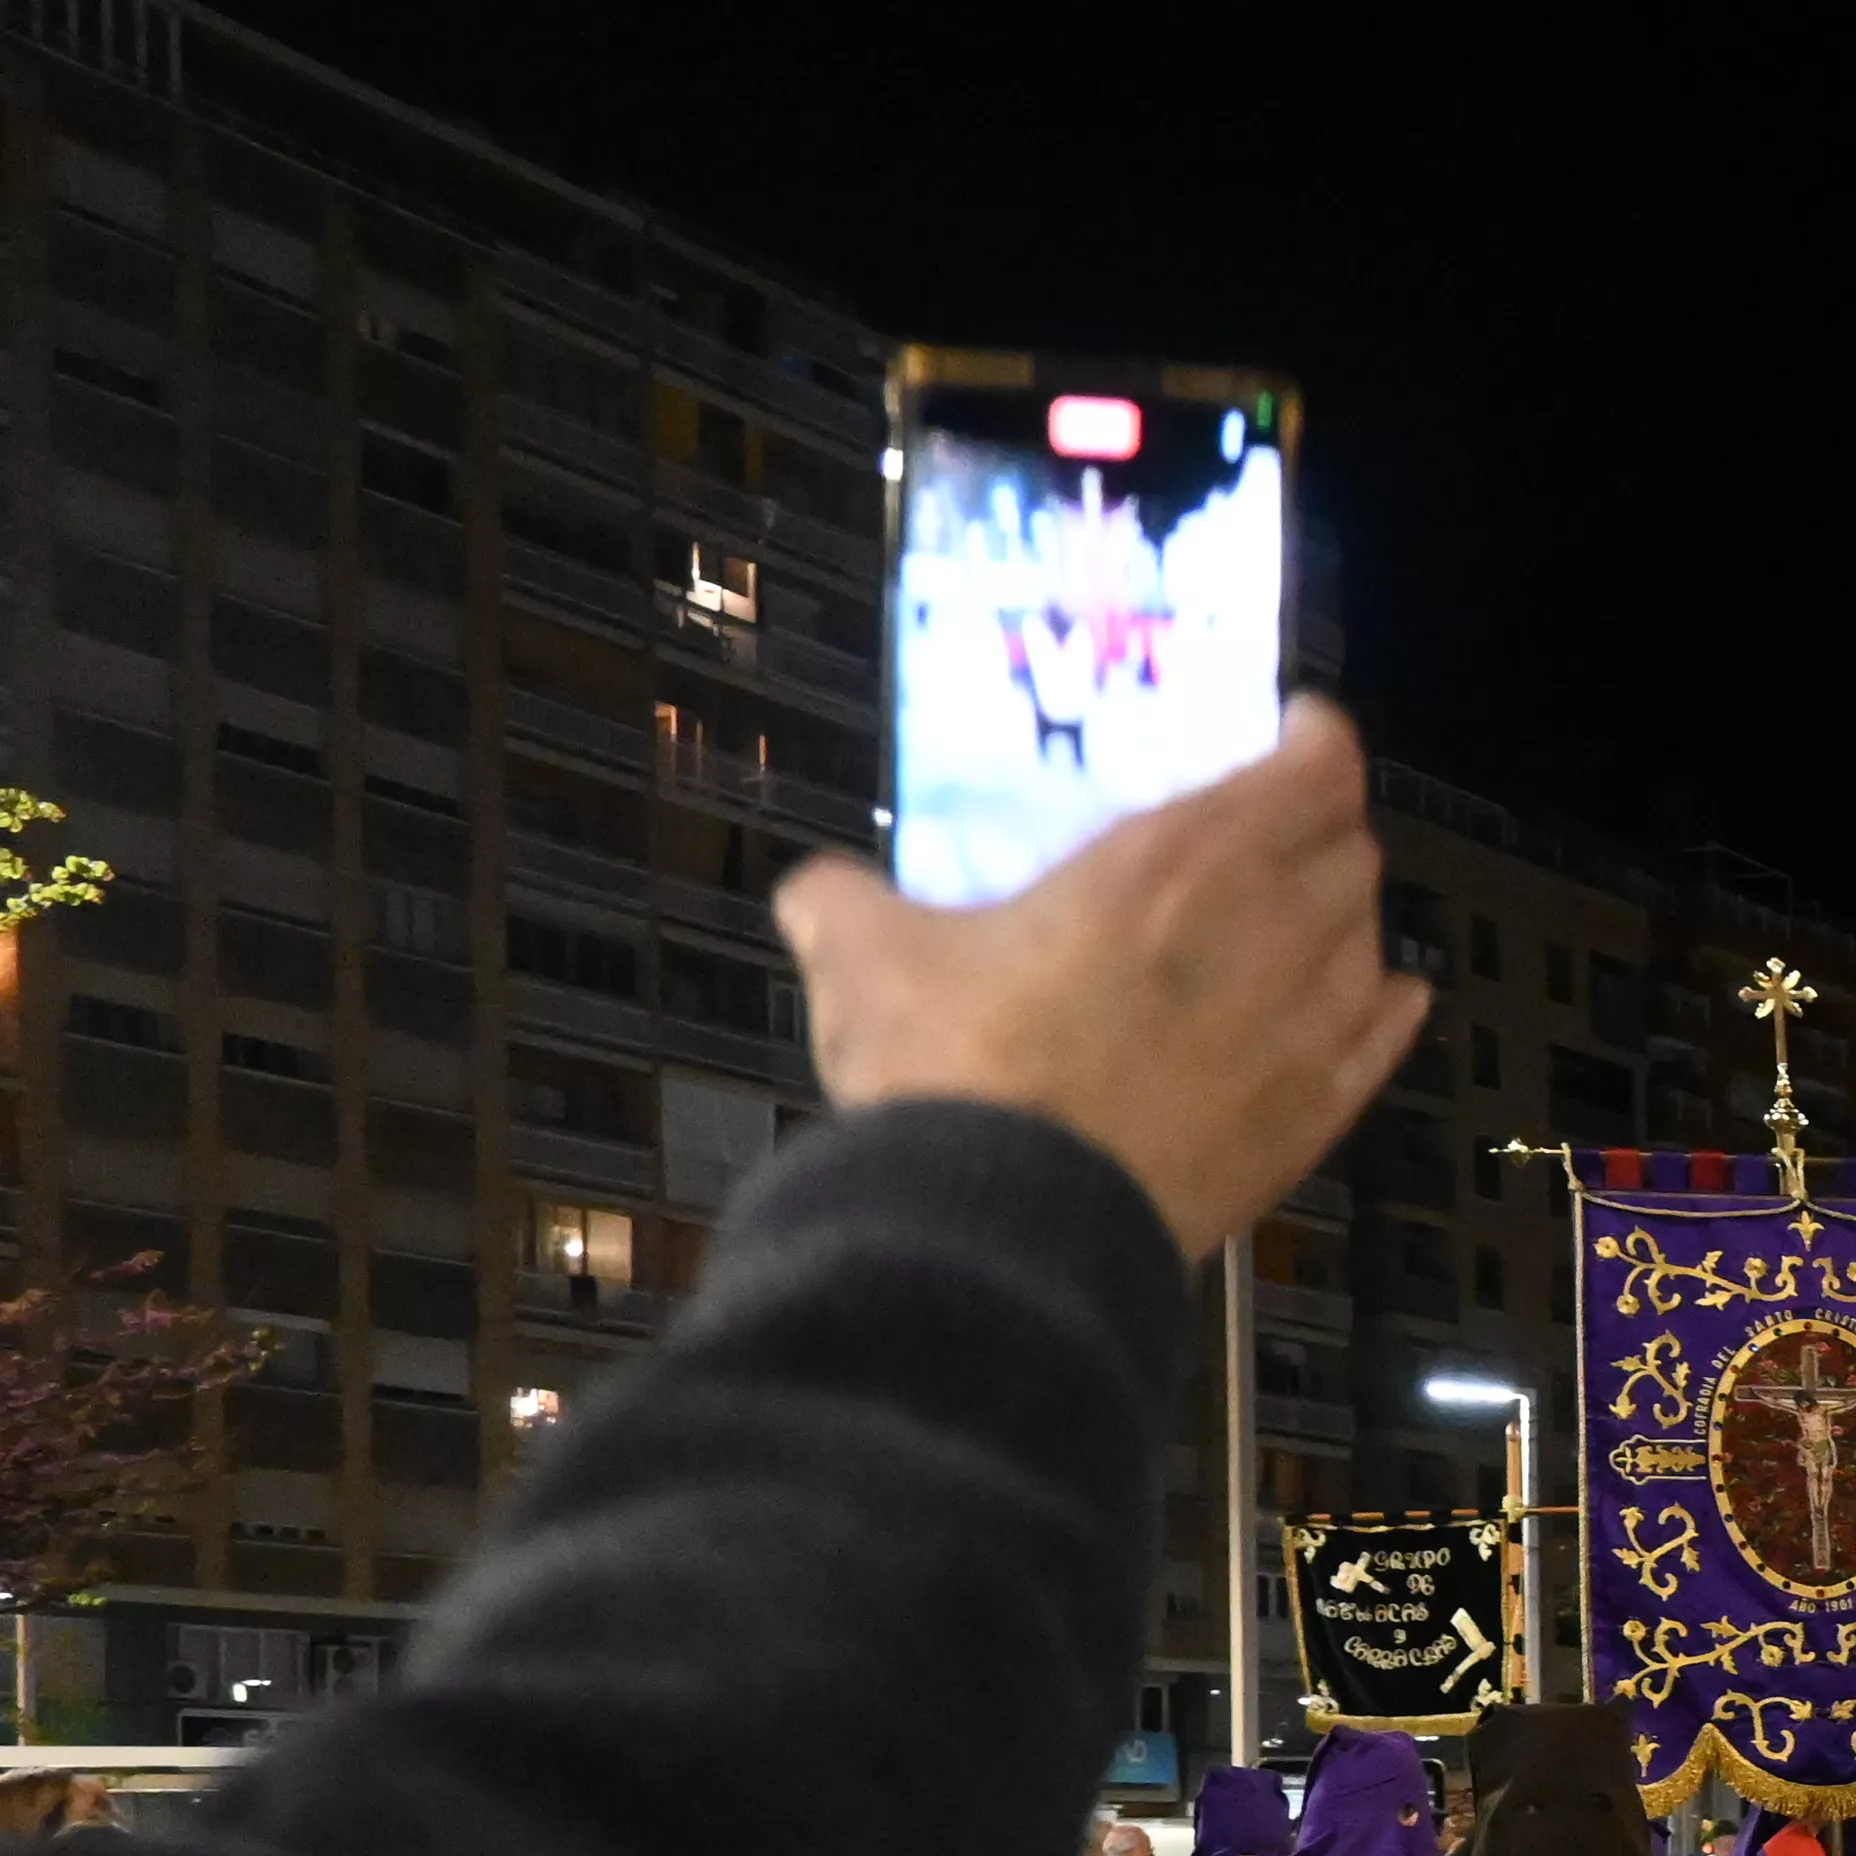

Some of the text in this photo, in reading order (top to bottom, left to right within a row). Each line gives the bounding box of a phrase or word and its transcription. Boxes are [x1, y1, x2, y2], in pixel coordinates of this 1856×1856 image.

[1692, 1376, 1717, 1436] COFRADIA
[1711, 1345, 1737, 1370] DEL
[1744, 1309, 1793, 1338] SANTO
[1373, 1547, 1451, 1572] GRUPO
[1406, 1573, 1436, 1596] DE
